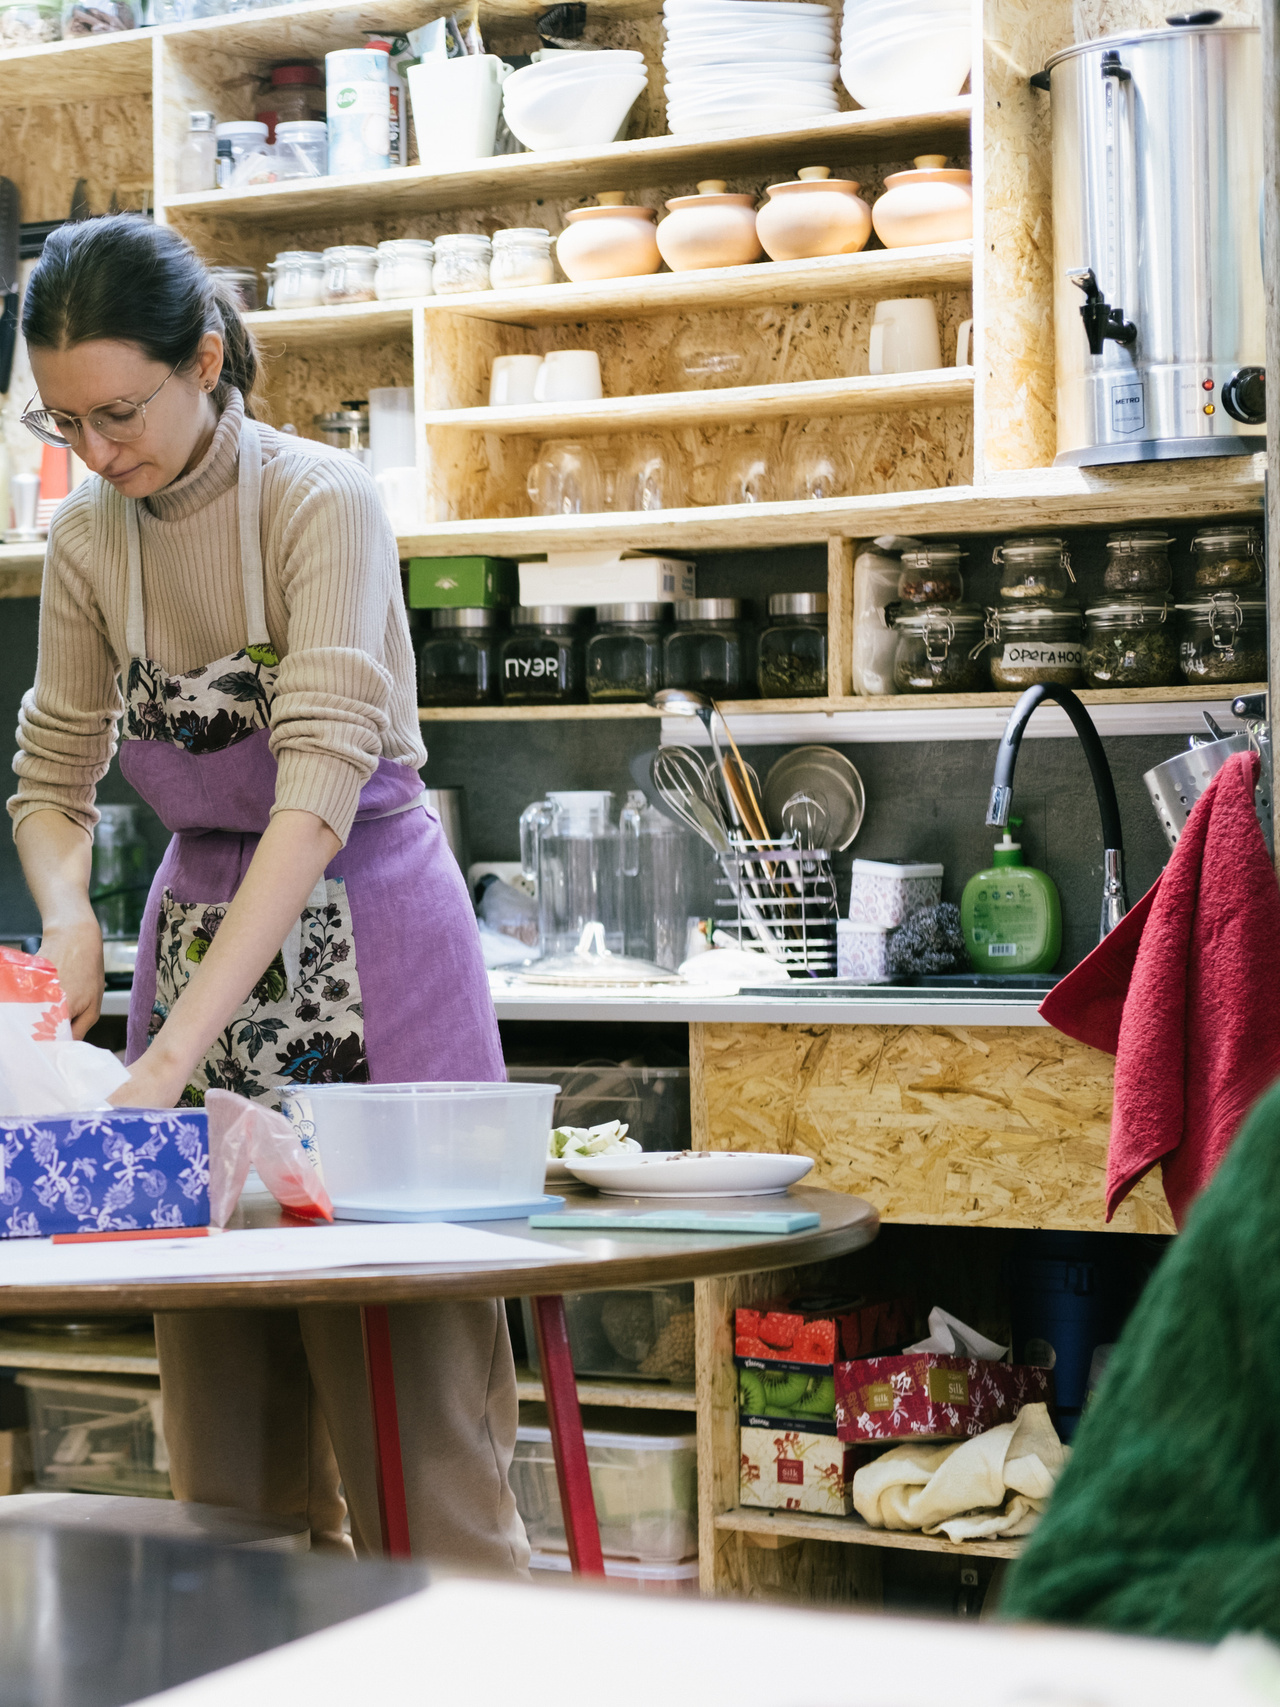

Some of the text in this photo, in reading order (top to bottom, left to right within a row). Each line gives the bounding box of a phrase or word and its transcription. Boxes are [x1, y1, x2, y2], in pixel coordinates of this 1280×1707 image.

[1115, 396, 1140, 405] METRO
[948, 1382, 964, 1395] Silk
[873, 1393, 889, 1403] Silk
[782, 1467, 798, 1478] Silk
